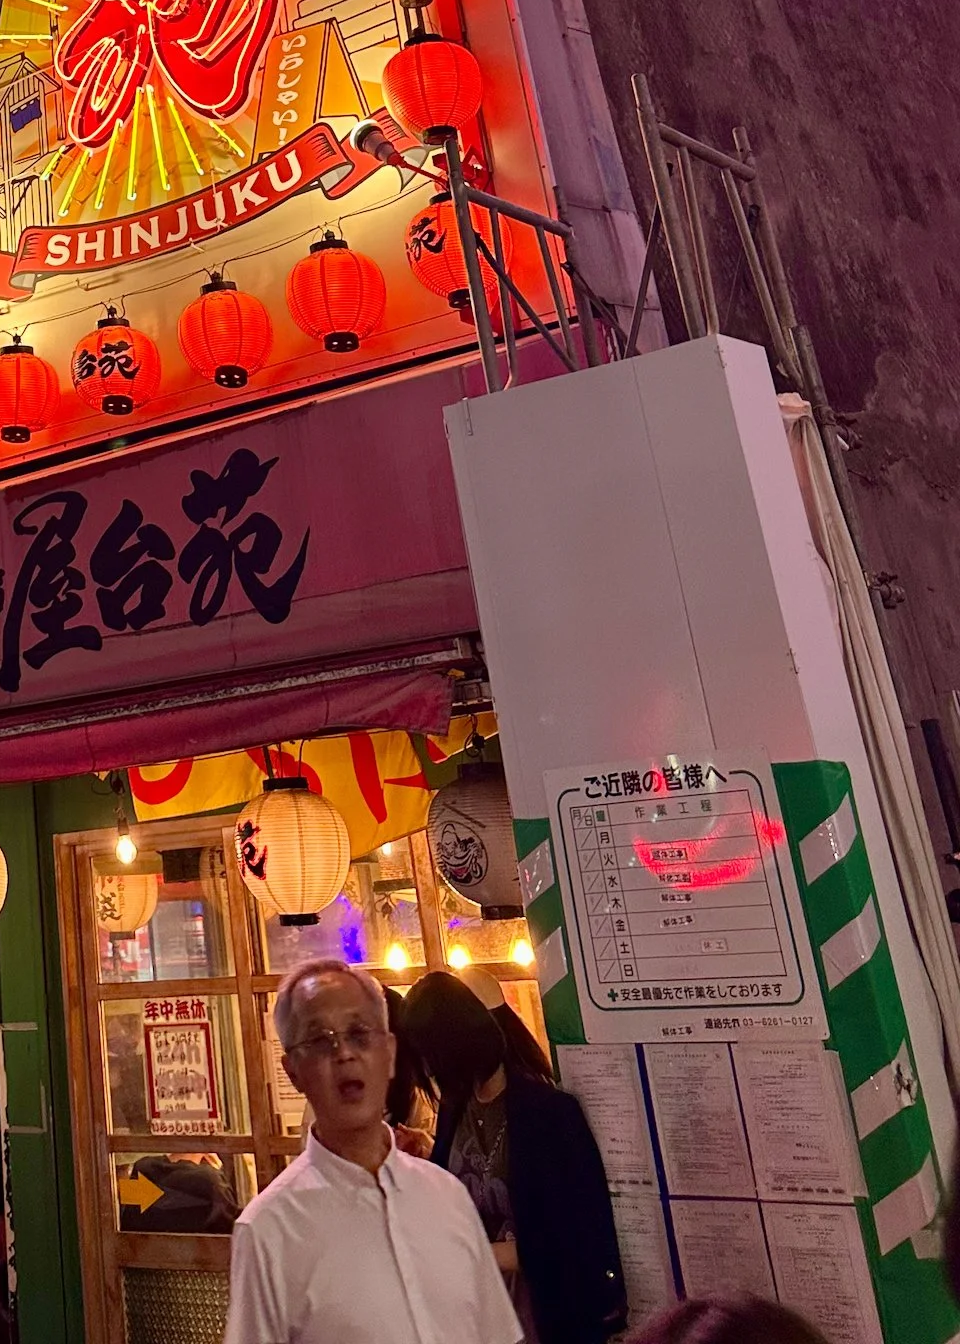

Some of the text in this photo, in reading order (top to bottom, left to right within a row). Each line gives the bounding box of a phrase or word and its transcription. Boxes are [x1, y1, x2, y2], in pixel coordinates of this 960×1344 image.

[45, 149, 302, 267] SHINJUKU
[583, 764, 727, 799] ご近隣の皆様へ
[600, 831, 610, 845] 月
[603, 853, 614, 866] 火
[607, 875, 618, 888] 水
[611, 897, 622, 909] 木
[615, 919, 626, 932] 金
[619, 941, 630, 954] 土
[624, 964, 634, 977] 日
[620, 983, 783, 1002] 安全最優先で作業をしております
[145, 998, 205, 1021] 年中無休
